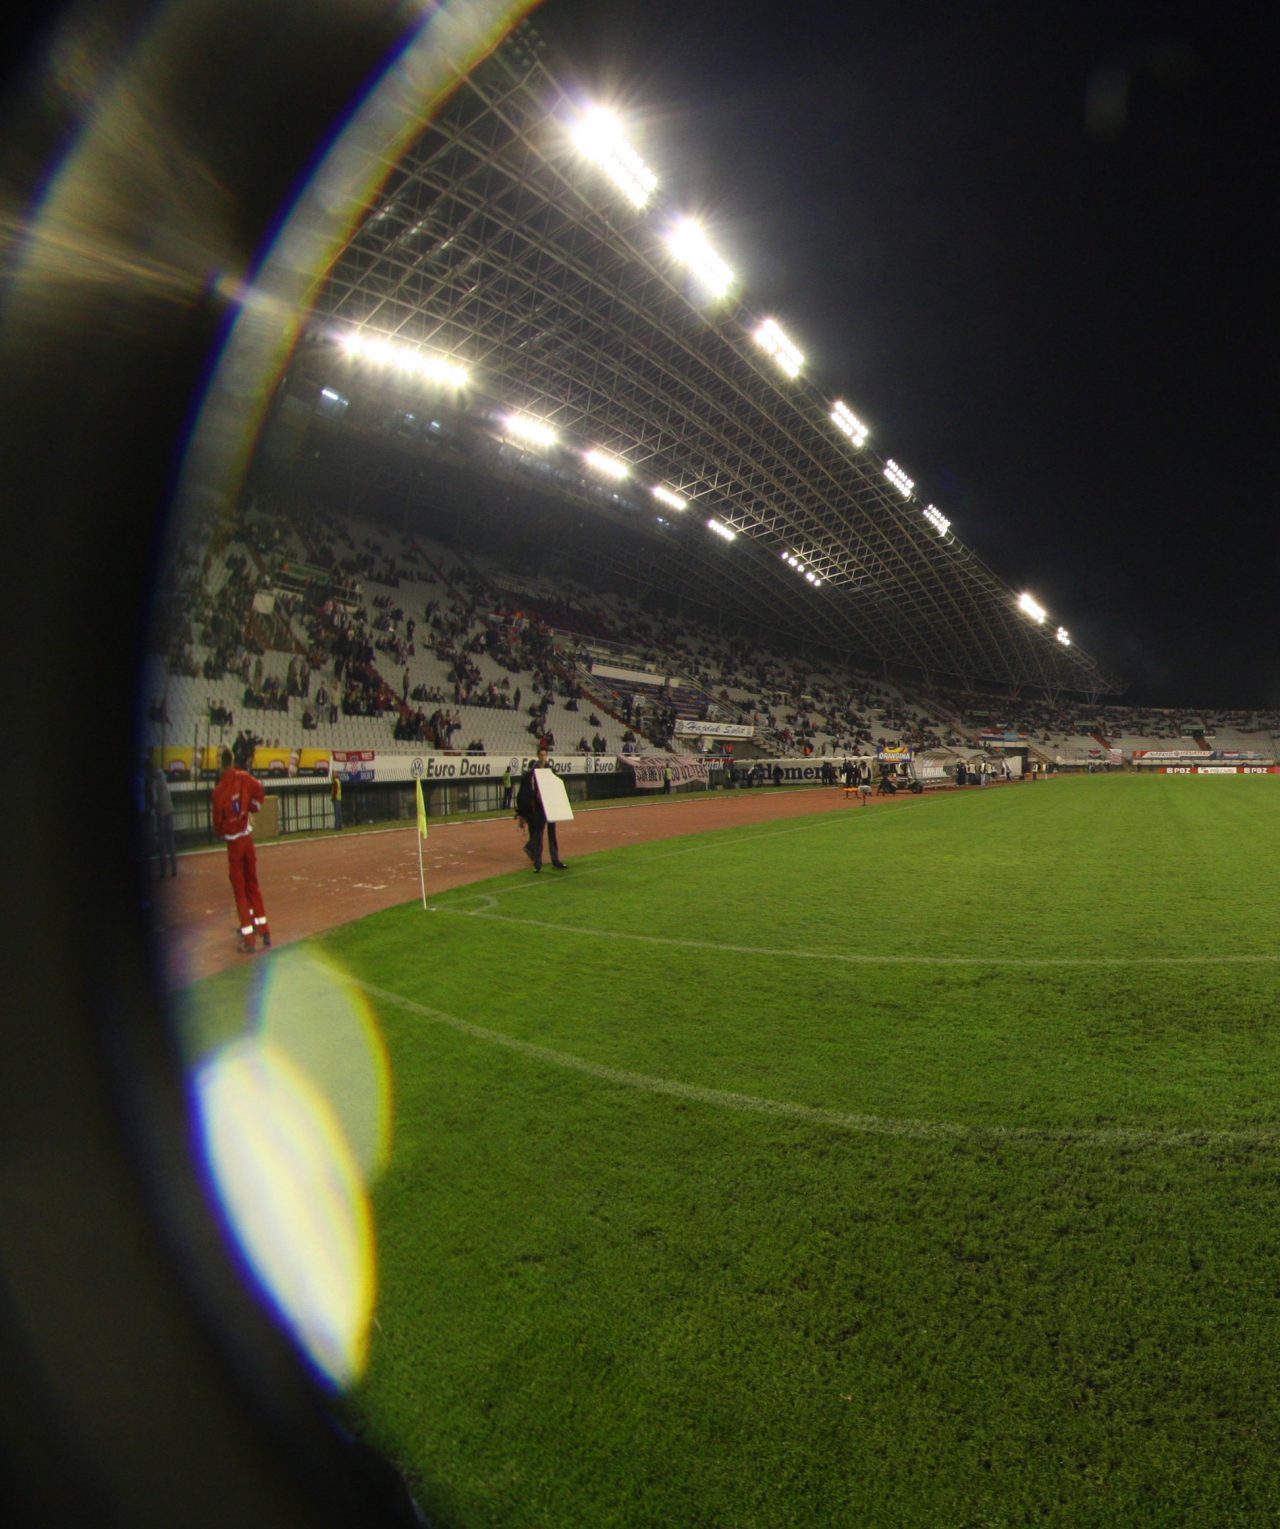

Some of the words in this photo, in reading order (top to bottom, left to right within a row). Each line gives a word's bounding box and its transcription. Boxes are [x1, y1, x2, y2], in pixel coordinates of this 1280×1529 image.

[427, 758, 456, 777] Euro
[460, 758, 490, 777] Daus
[594, 757, 614, 772] Euro
